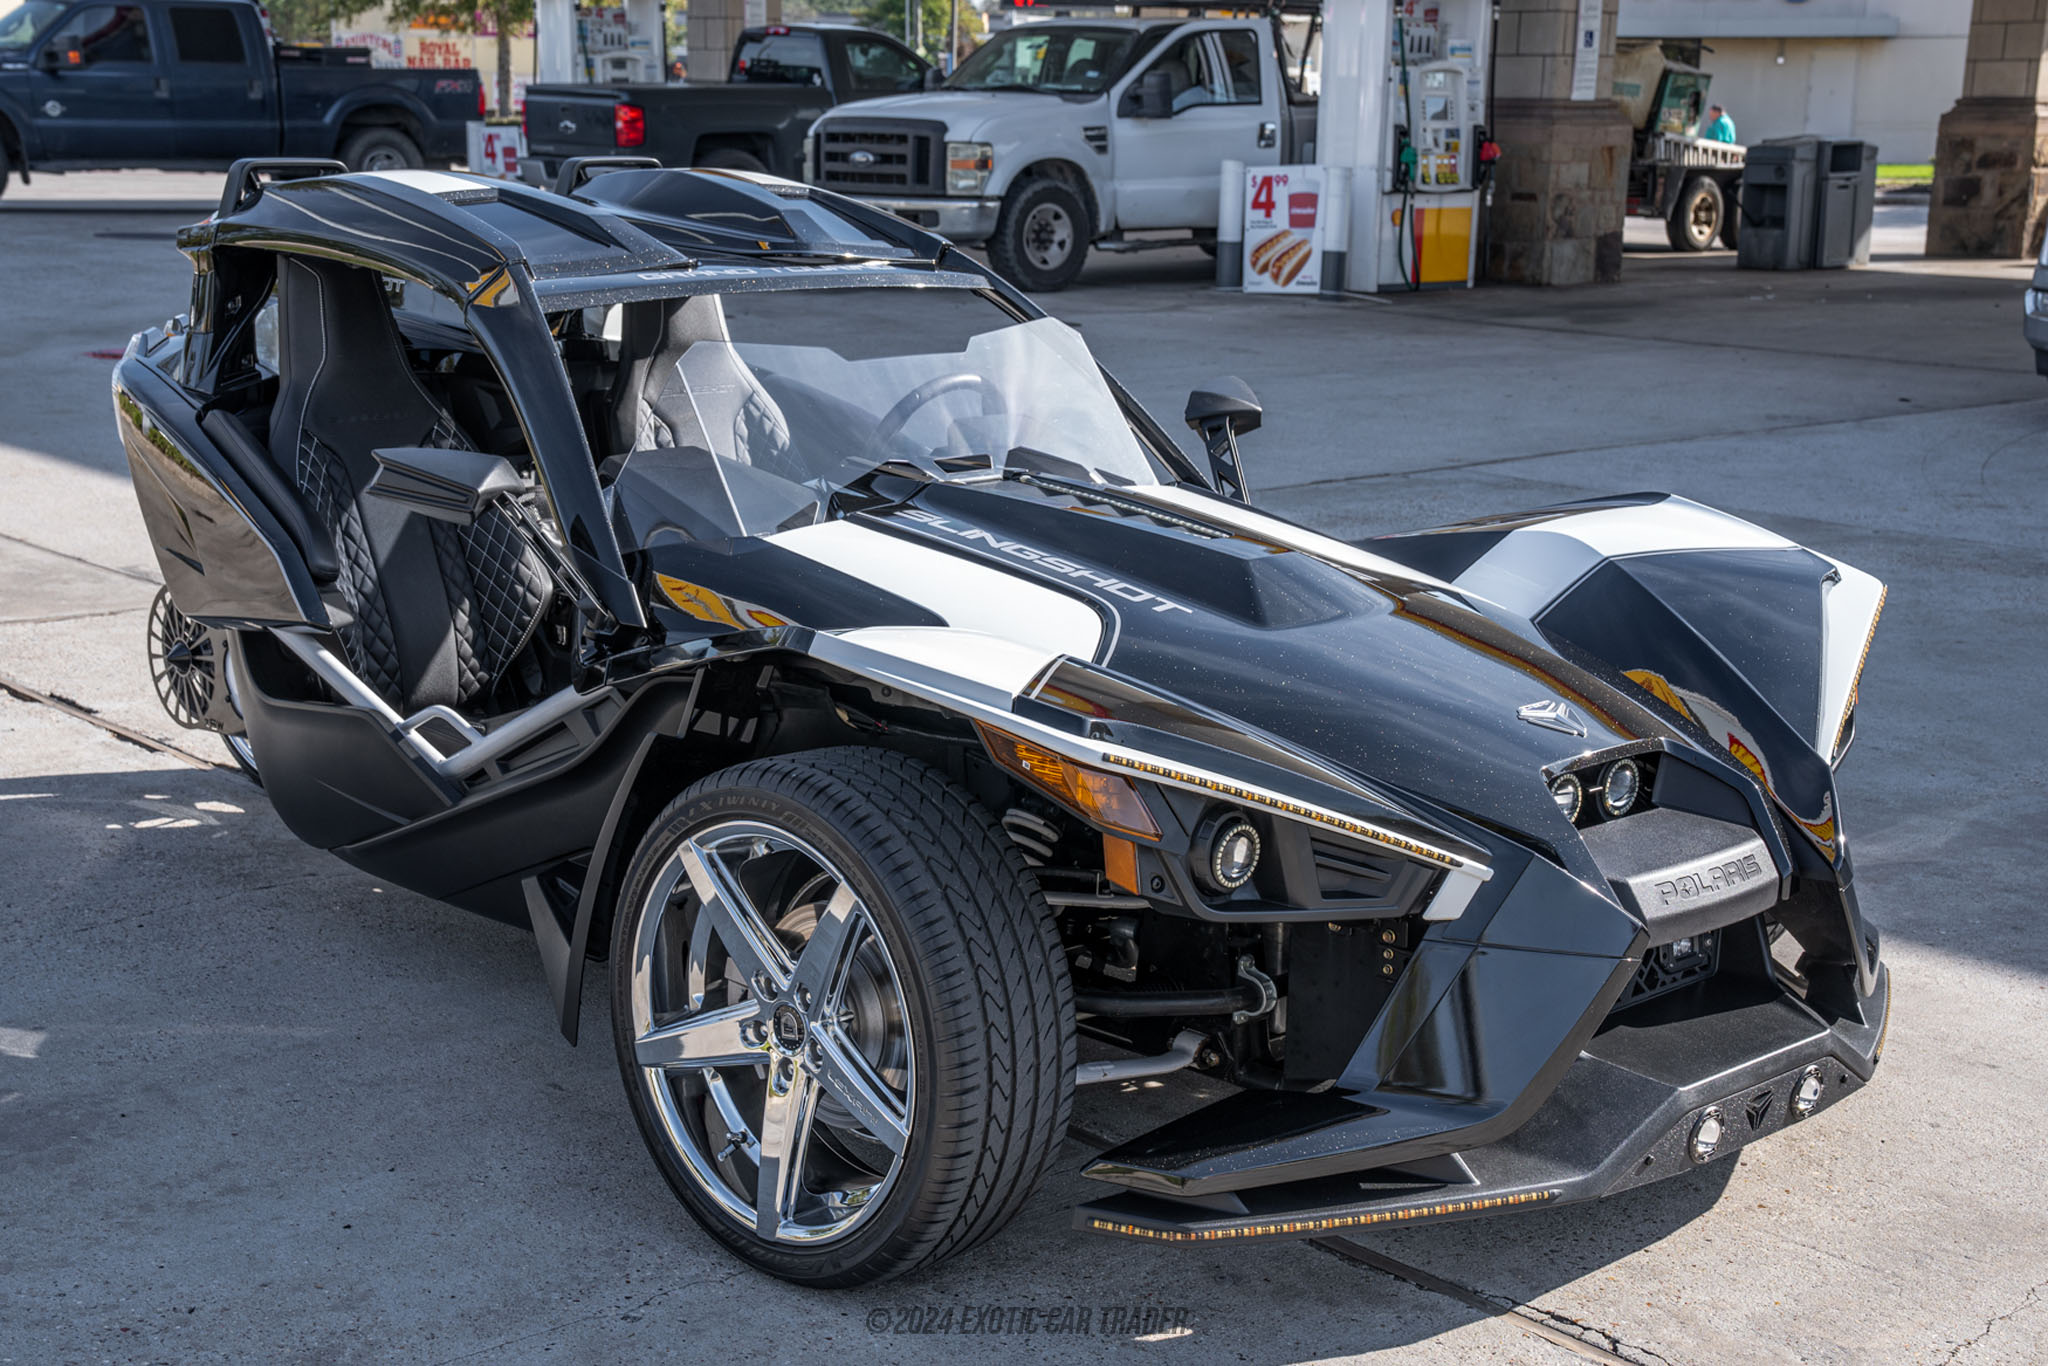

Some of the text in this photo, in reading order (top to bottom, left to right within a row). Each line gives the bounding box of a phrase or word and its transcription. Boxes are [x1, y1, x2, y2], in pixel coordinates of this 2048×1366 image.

[407, 56, 440, 69] NAIL
[443, 56, 472, 69] BAR
[419, 41, 460, 57] ROYAL
[893, 509, 1194, 615] SLINGSHOT
[1654, 853, 1762, 905] POLARIS
